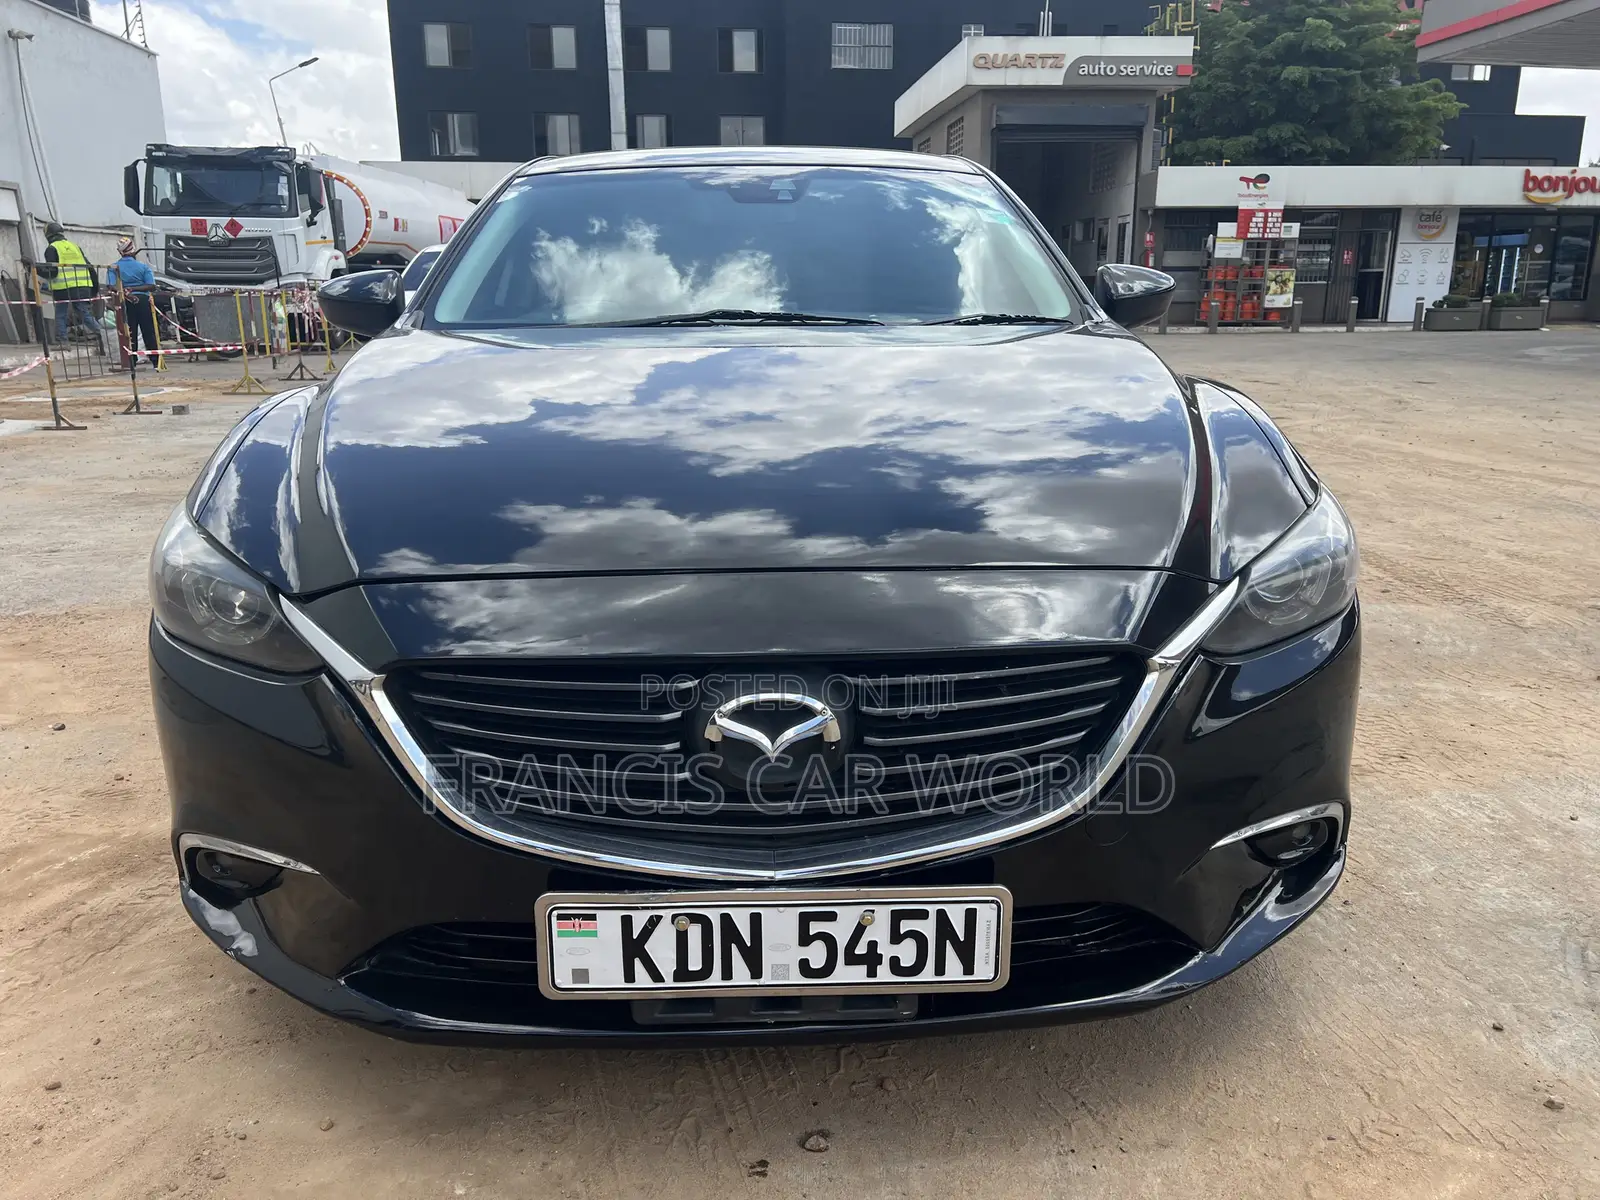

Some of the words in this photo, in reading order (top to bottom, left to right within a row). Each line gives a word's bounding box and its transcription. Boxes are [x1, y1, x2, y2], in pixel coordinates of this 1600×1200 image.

[973, 54, 1065, 69] QUARTZ
[1078, 61, 1117, 77] auto
[1120, 61, 1174, 77] service
[1419, 210, 1443, 223] café
[620, 911, 763, 983] KDN
[798, 907, 977, 978] 545N
